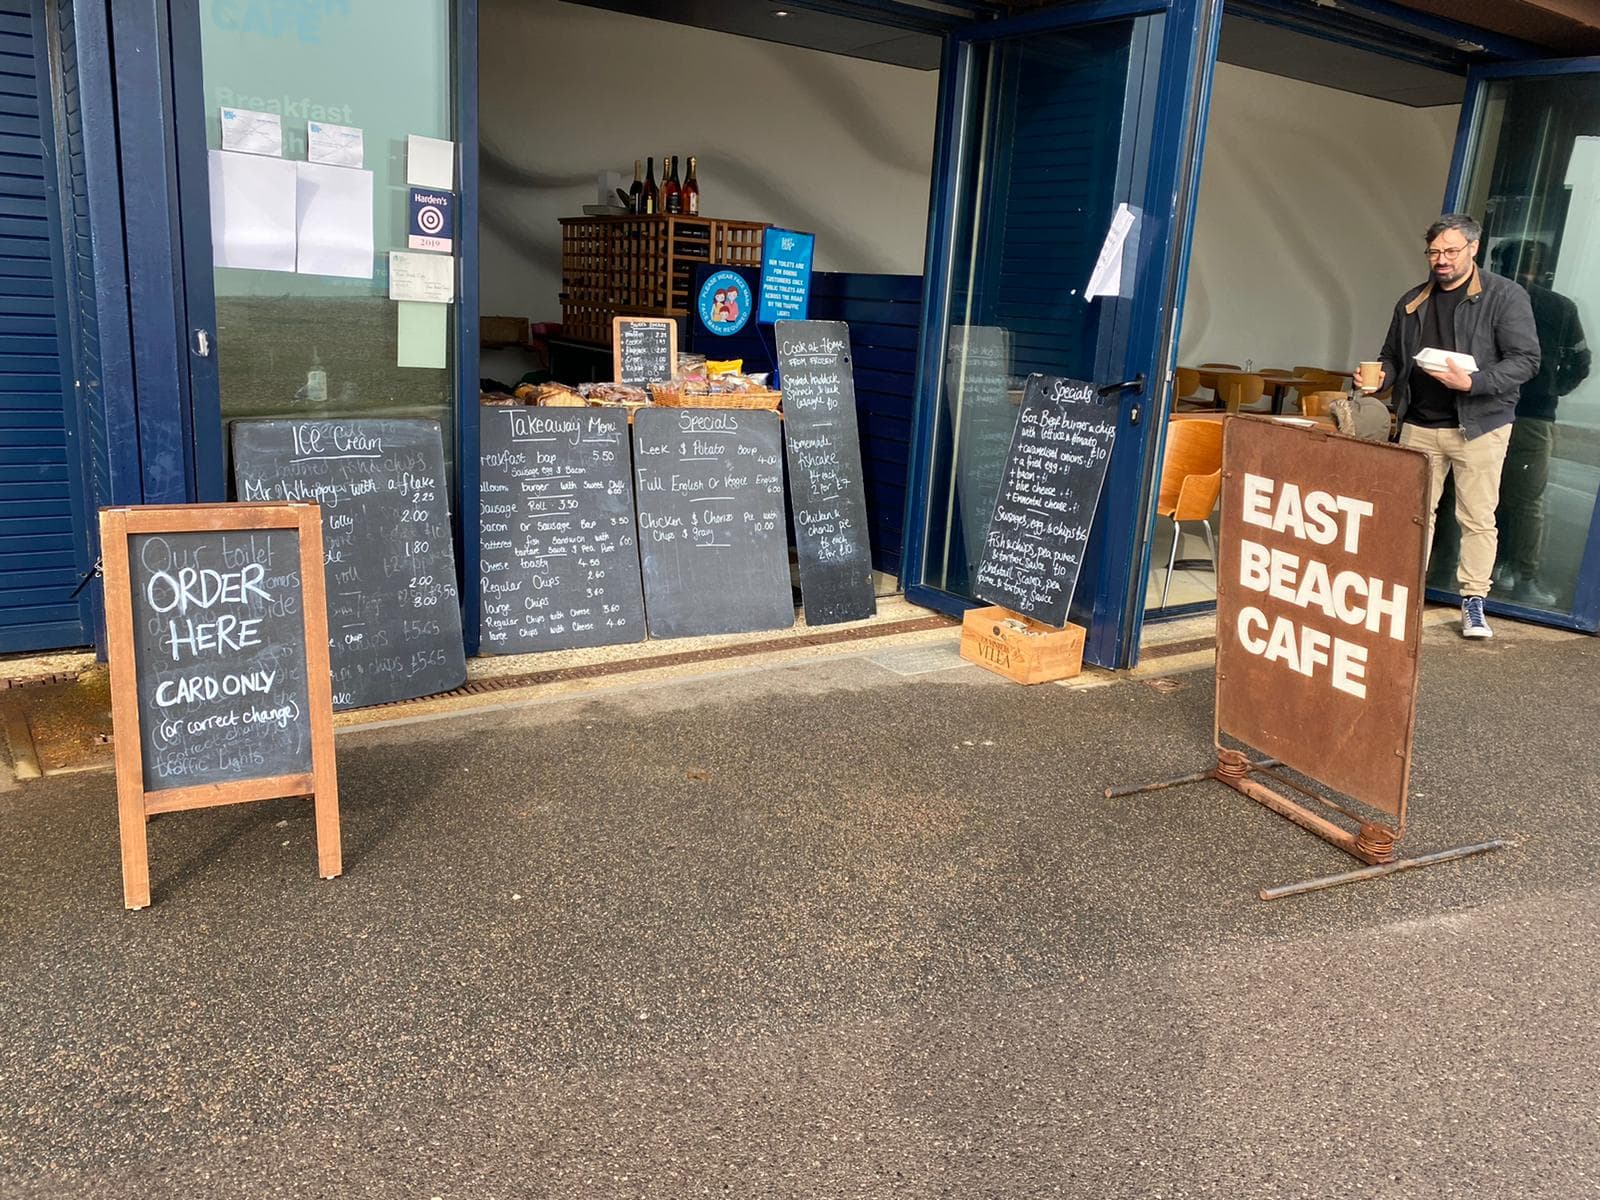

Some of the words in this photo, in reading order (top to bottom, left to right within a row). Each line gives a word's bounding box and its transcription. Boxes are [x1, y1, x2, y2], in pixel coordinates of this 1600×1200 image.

[414, 193, 448, 206] Harden's
[702, 277, 717, 298] PLEASE
[733, 276, 745, 288] FACE
[701, 303, 709, 321] FACE
[707, 319, 722, 332] MASK
[1050, 381, 1093, 404] Specials
[499, 410, 581, 445] Takeaway
[678, 410, 738, 432] Specials
[334, 426, 384, 454] Cream
[639, 437, 671, 456] Leek
[693, 440, 726, 456] Potato
[537, 451, 557, 464] bap
[1091, 446, 1107, 460] £10
[245, 479, 270, 502] Mr
[281, 480, 338, 509] Whippy
[388, 479, 397, 490] a
[395, 472, 435, 496] flake
[521, 482, 550, 497] burger
[638, 468, 667, 492] Full
[671, 474, 704, 497] English
[811, 485, 820, 494] 2
[401, 509, 428, 522] 2.00
[558, 499, 579, 511] 3.50
[1242, 472, 1374, 555] EAST
[537, 521, 572, 534] Sausage
[142, 537, 207, 574] Our
[222, 535, 275, 569] toilet
[520, 557, 549, 574] toasty
[818, 550, 825, 560] 2
[147, 563, 275, 616] ORDER
[480, 577, 523, 600] Regular
[1239, 539, 1409, 642] BEACH
[485, 617, 519, 632] Regular
[165, 615, 263, 661] HERE
[1237, 606, 1369, 699] CAFE
[156, 676, 220, 707] CARD
[223, 670, 276, 696] ONLY
[160, 719, 183, 742] (or
[187, 710, 239, 735] correct
[242, 700, 300, 728] change)
